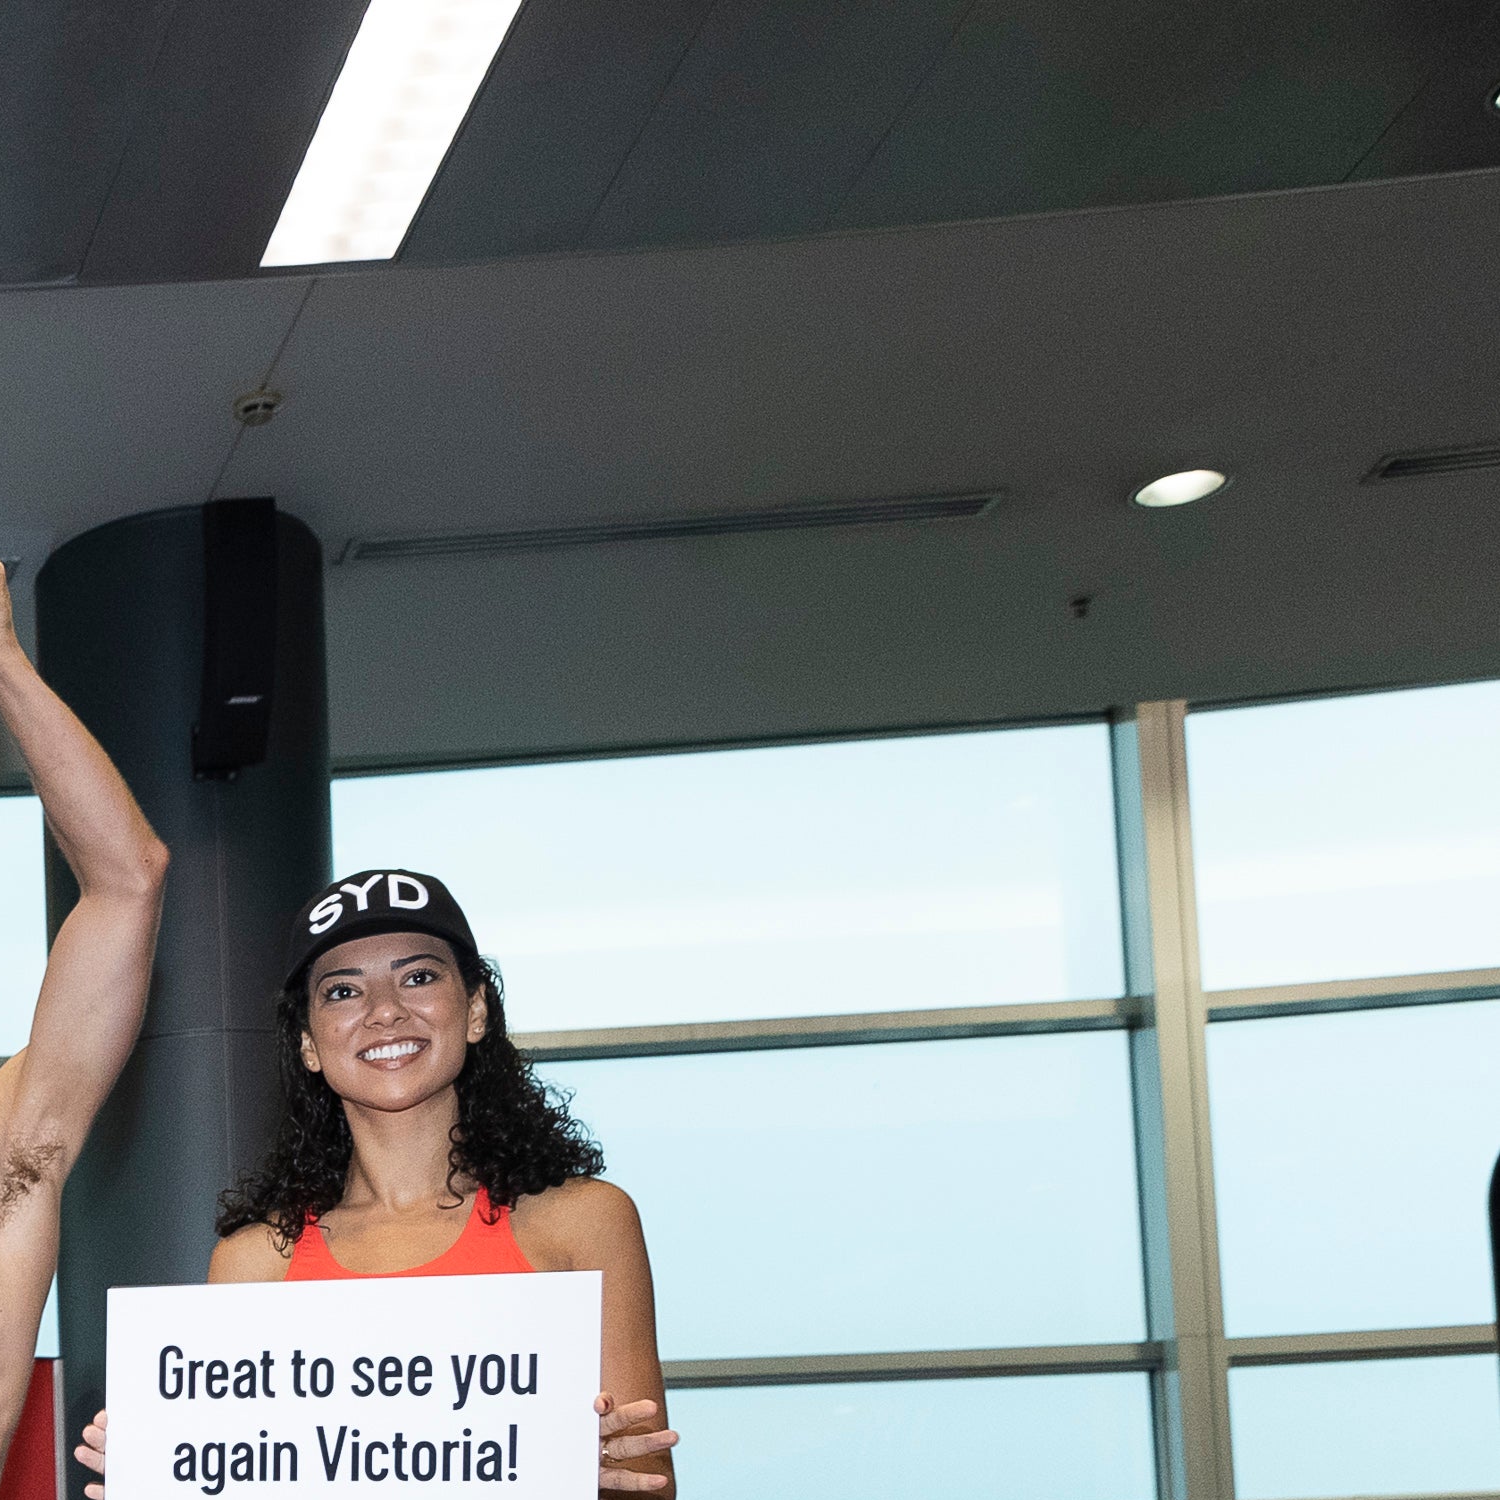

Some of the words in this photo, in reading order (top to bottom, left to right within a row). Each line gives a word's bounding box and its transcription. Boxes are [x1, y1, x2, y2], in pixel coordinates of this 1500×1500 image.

[309, 874, 428, 934] SYD
[158, 1346, 275, 1400] Great
[292, 1350, 334, 1398] to
[351, 1356, 433, 1397] see
[451, 1353, 538, 1410] you
[173, 1430, 297, 1496] again
[316, 1424, 518, 1482] Victoria!
